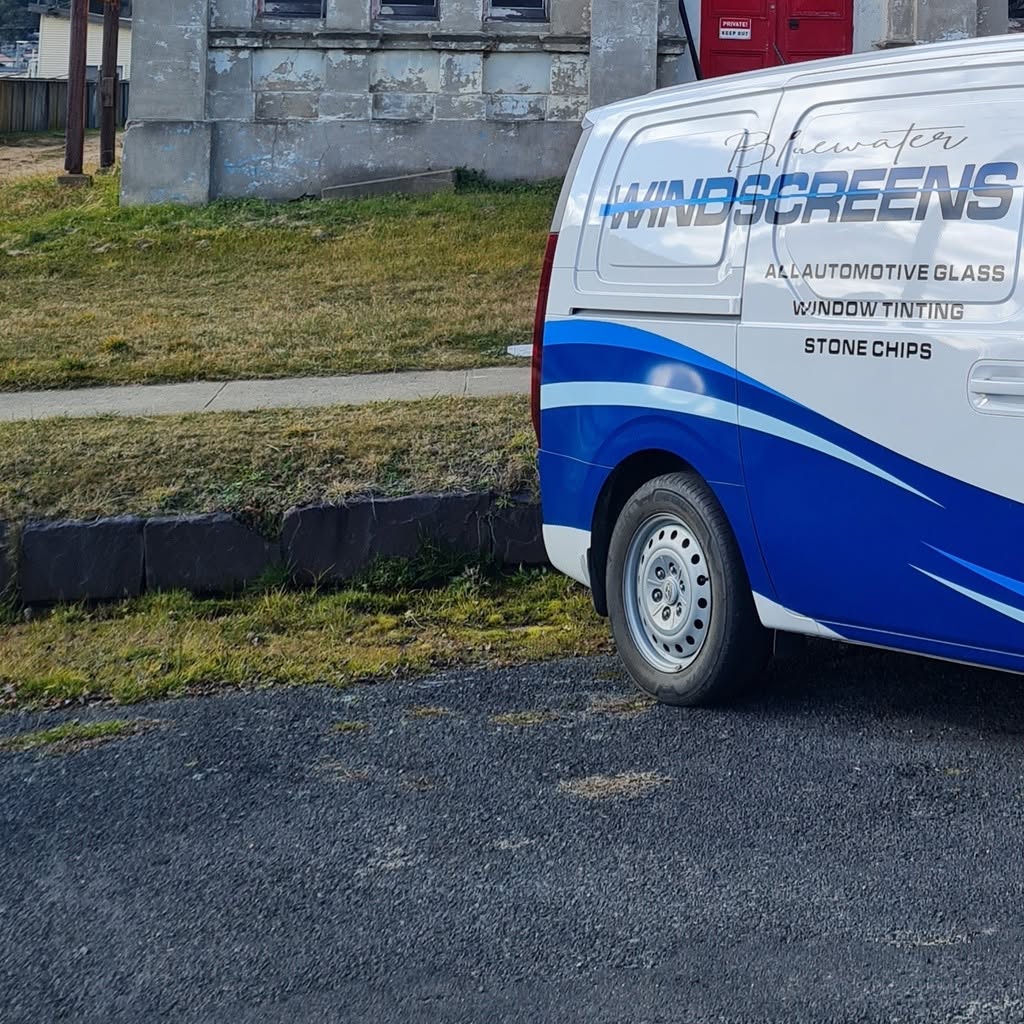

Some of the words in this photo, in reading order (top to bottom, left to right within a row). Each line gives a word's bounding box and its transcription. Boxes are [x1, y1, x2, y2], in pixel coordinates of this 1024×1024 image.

[724, 122, 969, 174] Bluewater
[610, 162, 1019, 230] WINDSCREENS
[933, 263, 1006, 283] GLASS
[793, 299, 878, 317] WINDOW
[882, 302, 965, 320] TINTING
[804, 337, 868, 356] STONE
[872, 340, 932, 360] CHIPS
